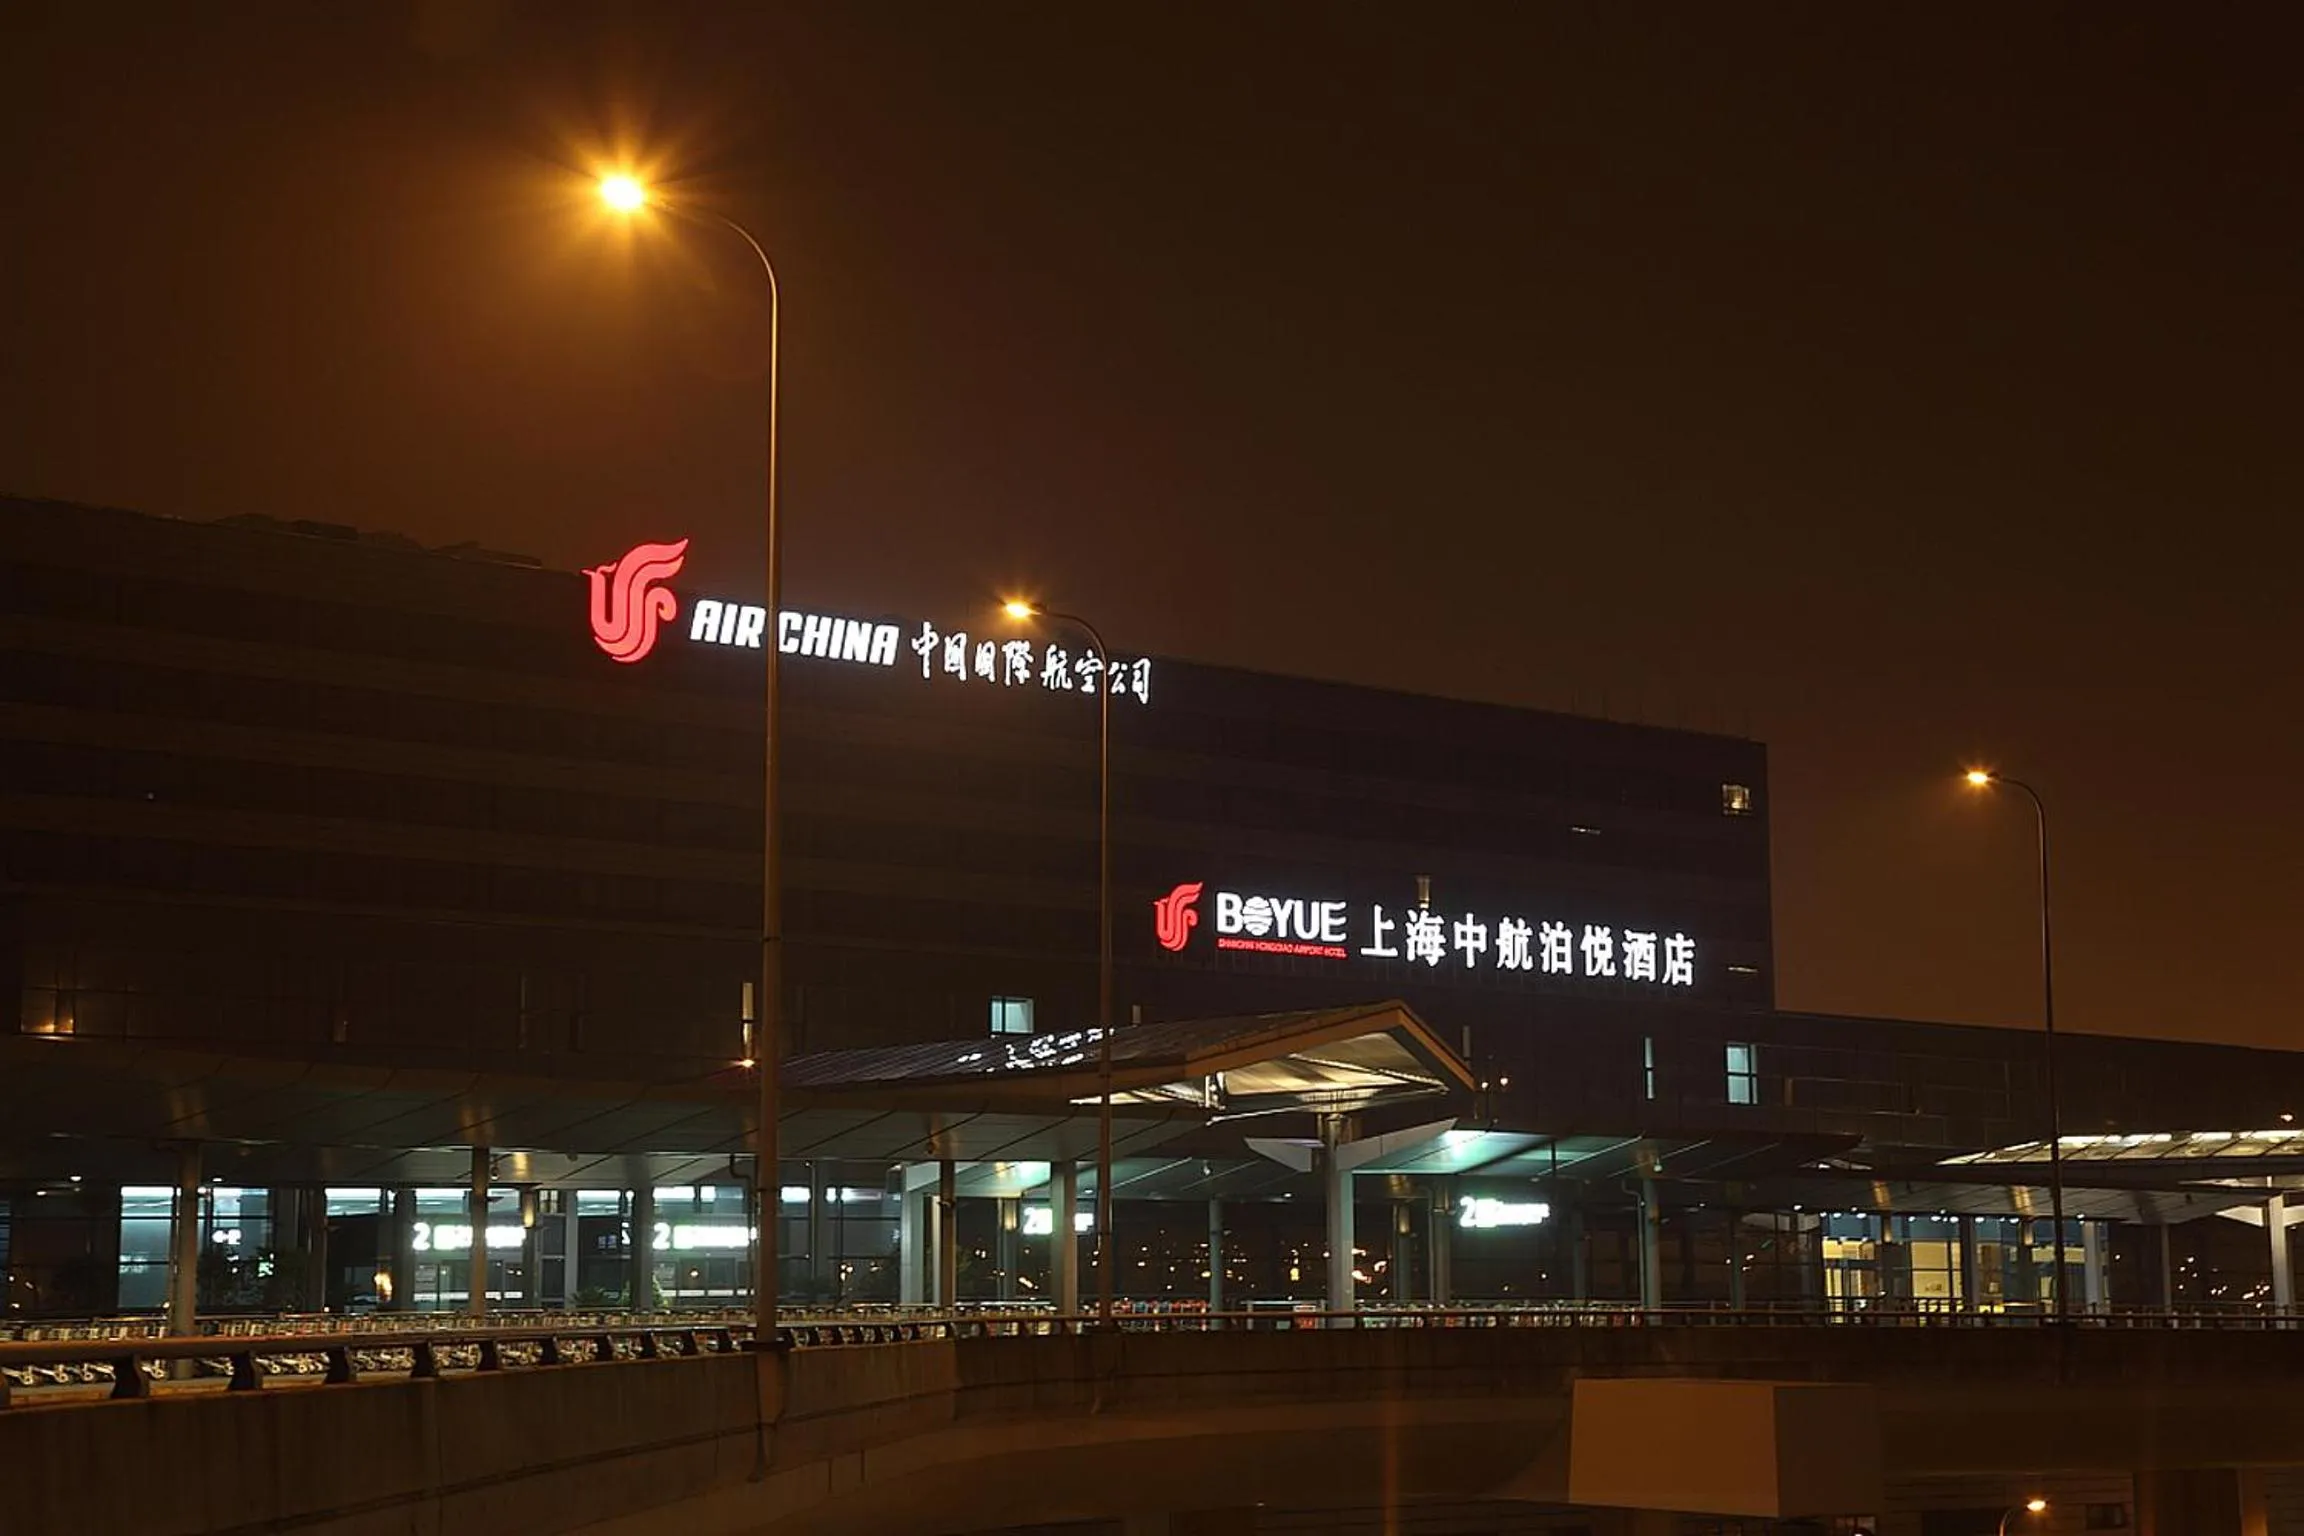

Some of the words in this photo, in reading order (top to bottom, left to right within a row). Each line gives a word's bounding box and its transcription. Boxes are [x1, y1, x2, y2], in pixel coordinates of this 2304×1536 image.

[690, 599, 766, 648] AIR
[778, 611, 900, 666] CHINA
[1216, 891, 1347, 942] BOYUE
[1360, 903, 1696, 986] 上海中航泊悦酒店
[1460, 1196, 1476, 1228] 2
[412, 1222, 431, 1251] 2
[652, 1222, 671, 1250] 2
